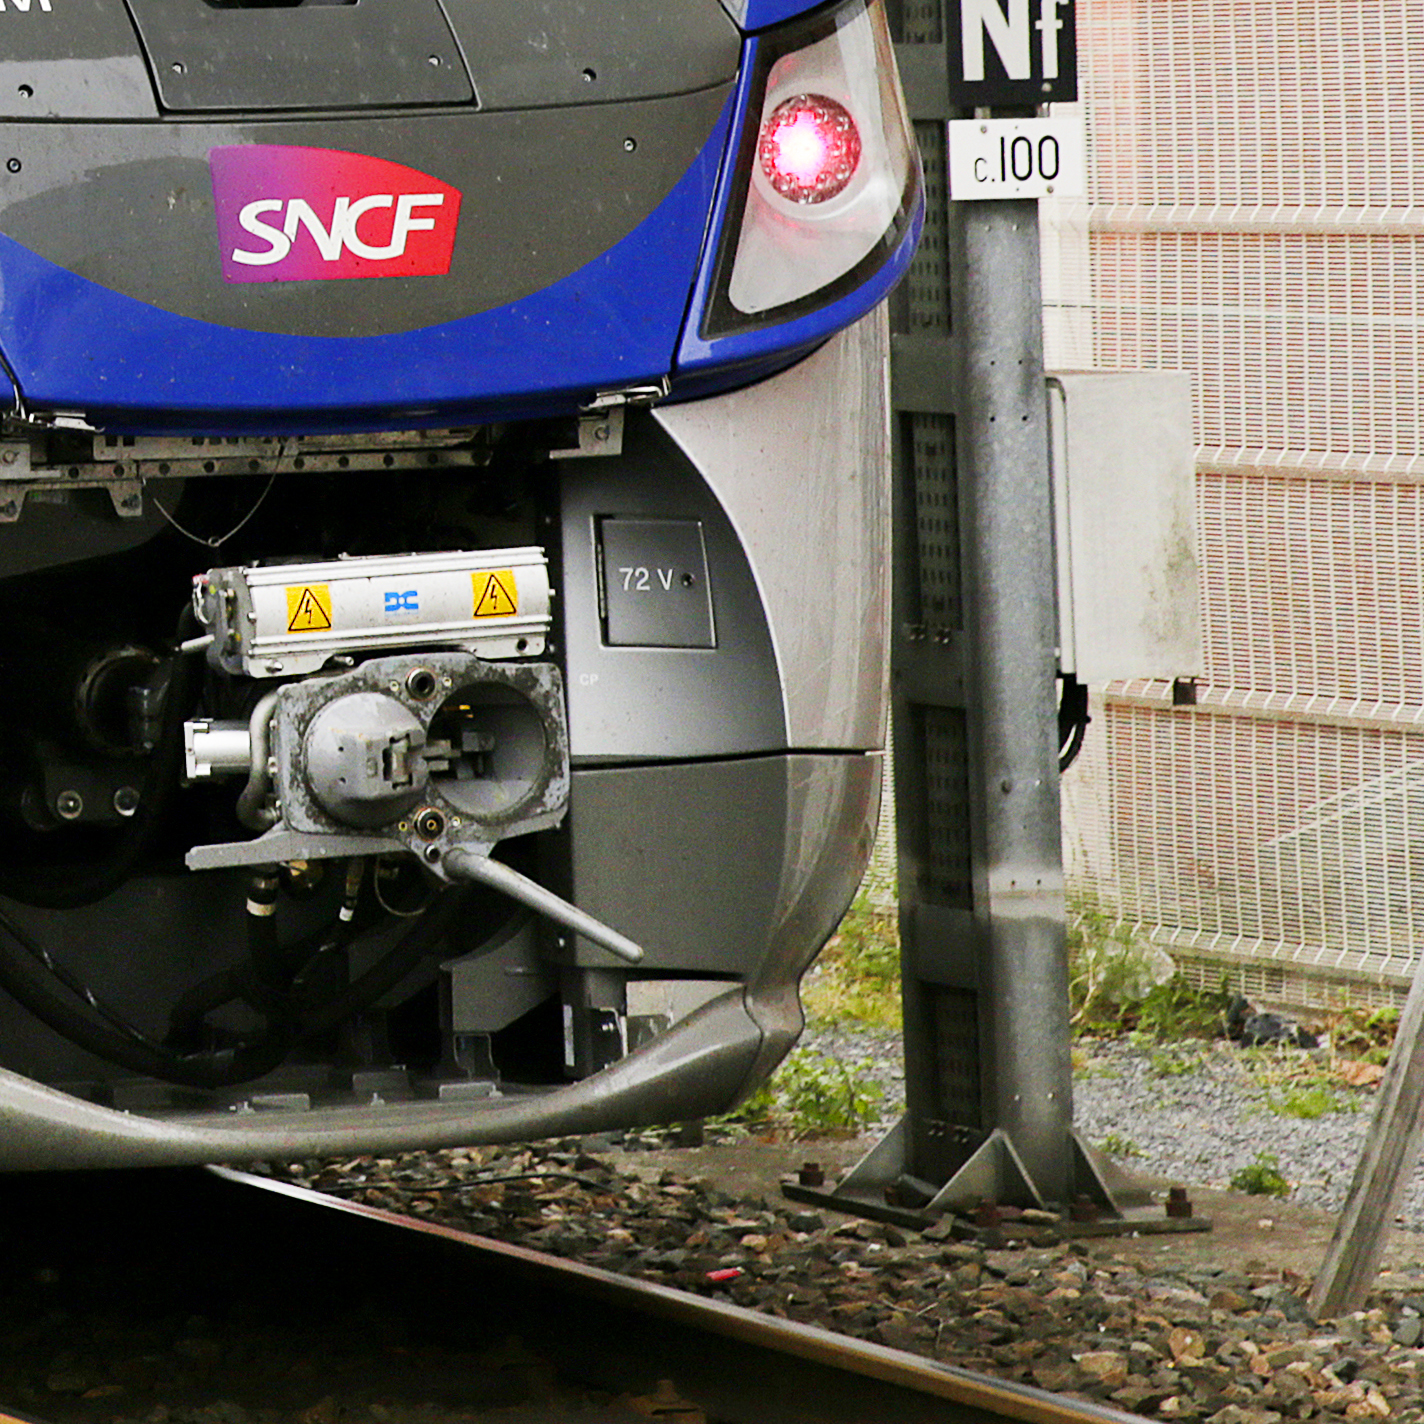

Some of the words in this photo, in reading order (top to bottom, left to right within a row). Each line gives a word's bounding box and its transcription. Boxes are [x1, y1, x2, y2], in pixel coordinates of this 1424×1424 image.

[974, 134, 1060, 183] c.100
[231, 193, 445, 266] SNCF
[618, 567, 651, 591] 72
[657, 568, 673, 591] V
[579, 673, 599, 686] CP
